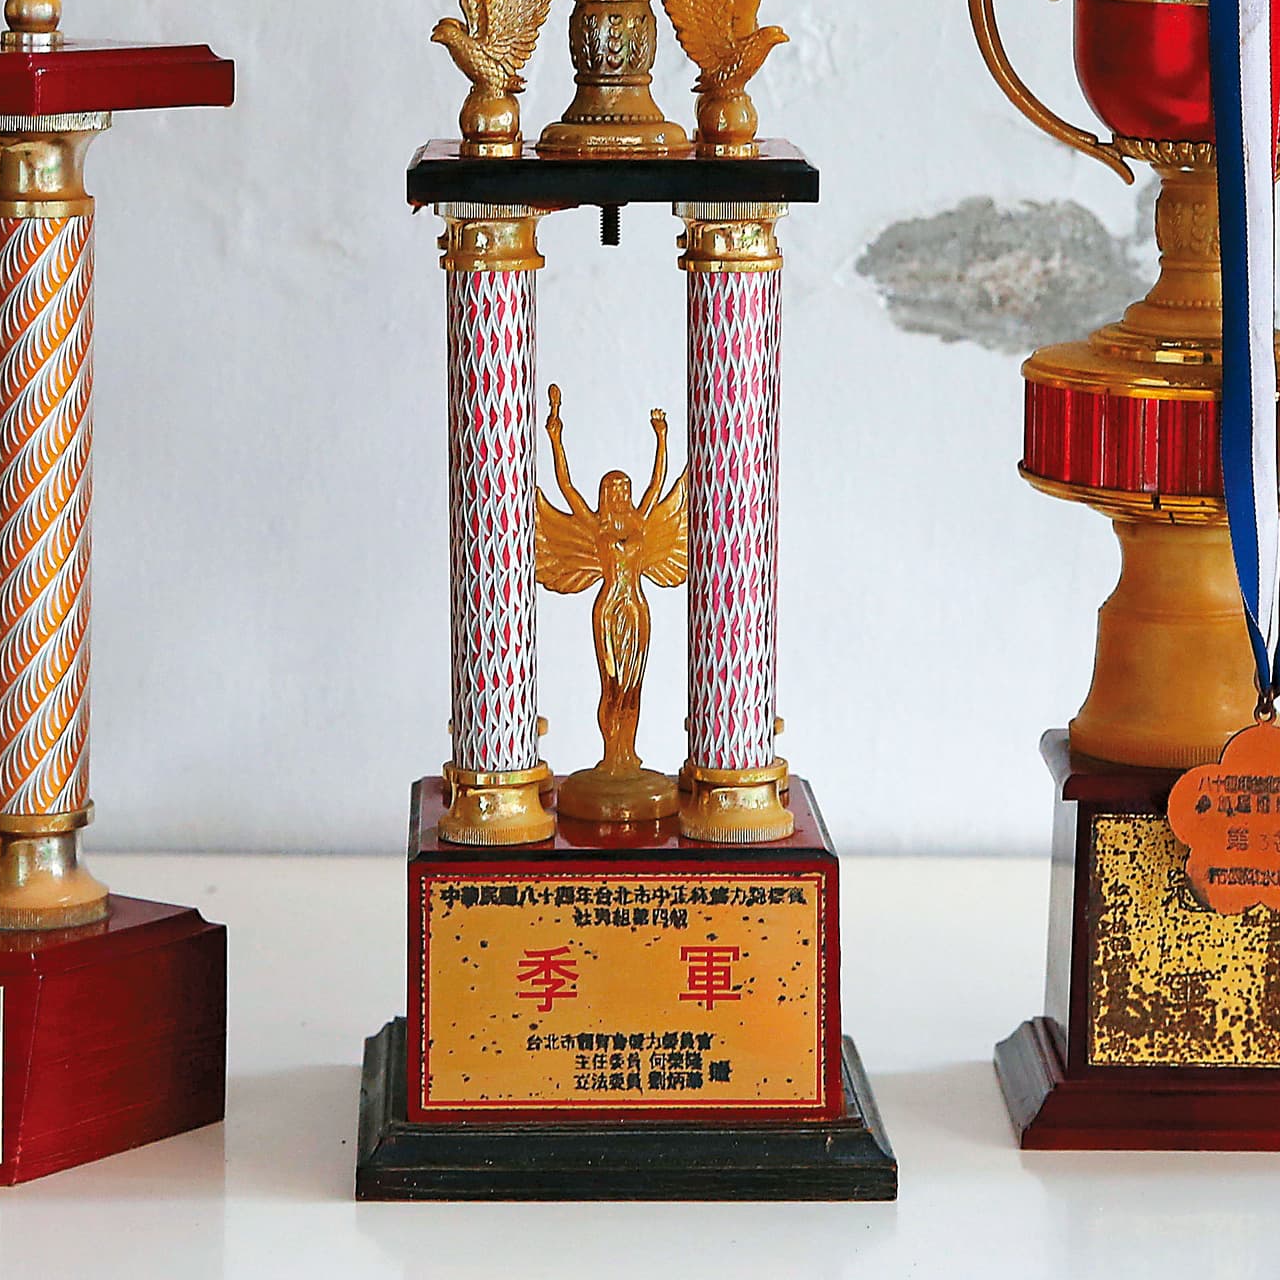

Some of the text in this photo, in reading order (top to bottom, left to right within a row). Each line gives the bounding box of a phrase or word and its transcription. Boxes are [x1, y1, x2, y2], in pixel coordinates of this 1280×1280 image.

[516, 945, 742, 1012] 季軍
[575, 1053, 641, 1070] 主任委員
